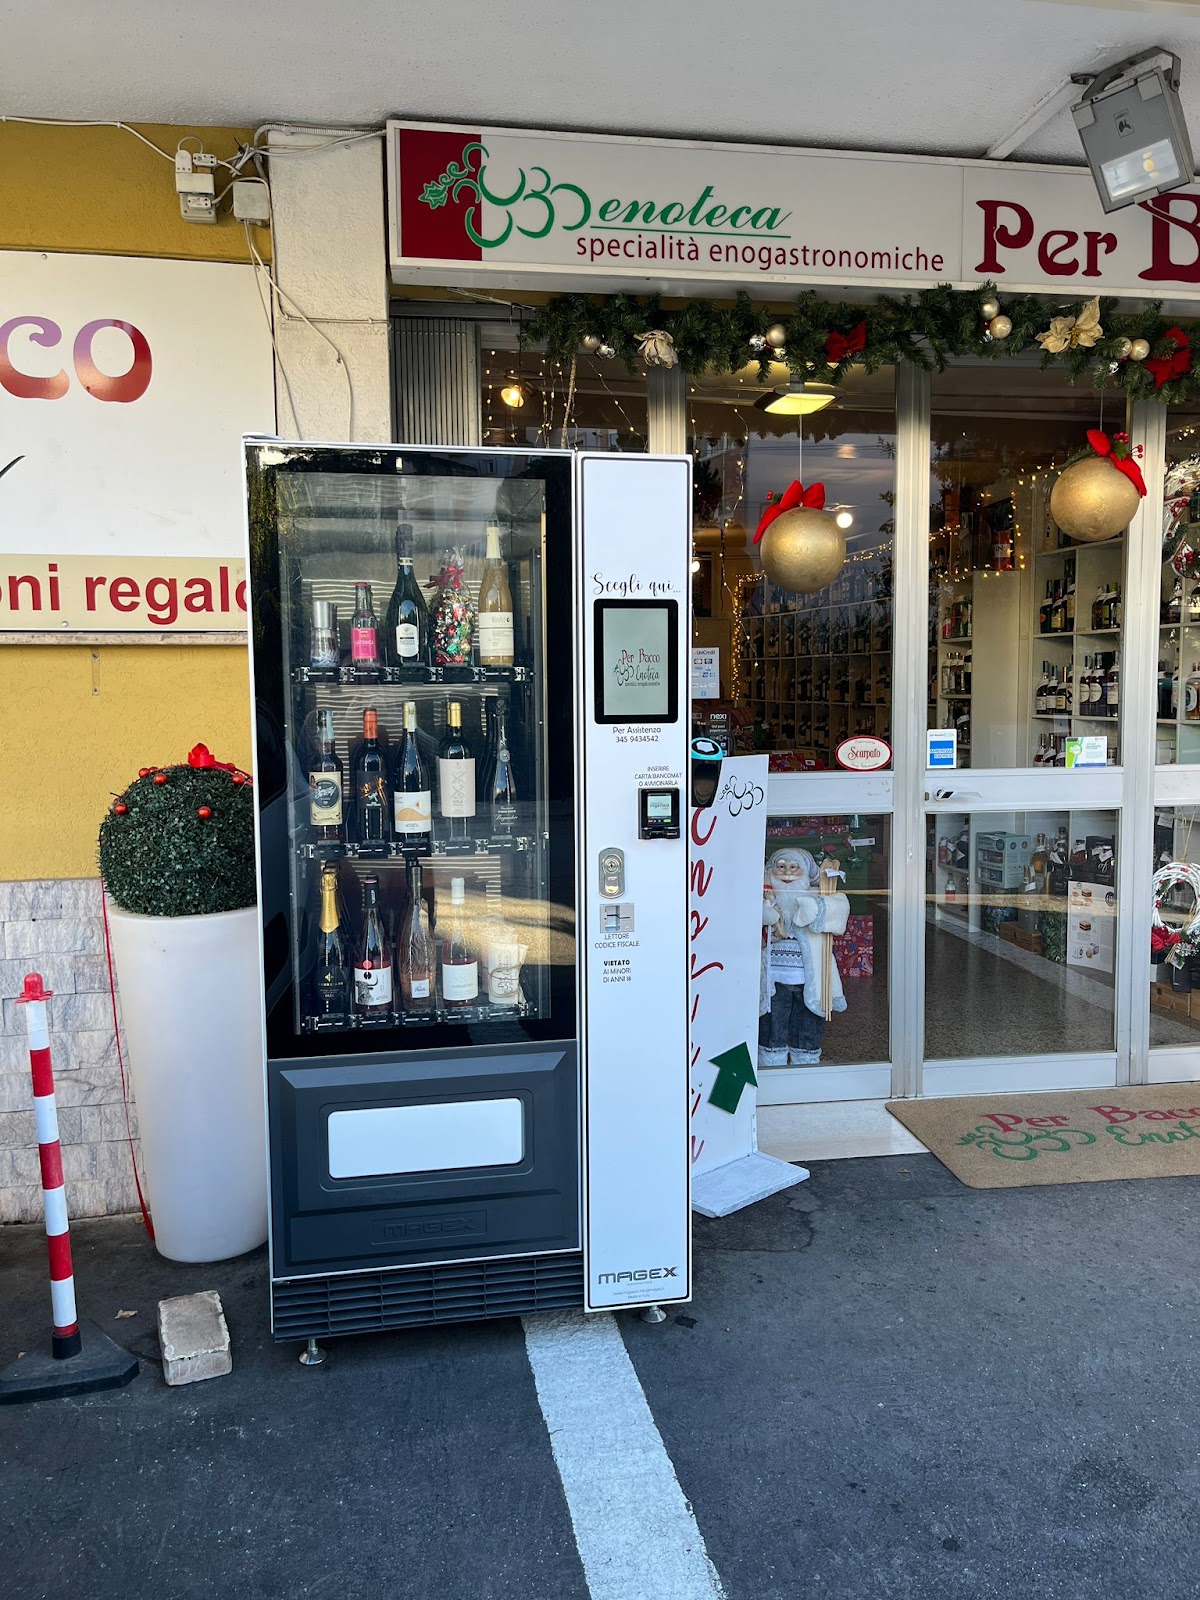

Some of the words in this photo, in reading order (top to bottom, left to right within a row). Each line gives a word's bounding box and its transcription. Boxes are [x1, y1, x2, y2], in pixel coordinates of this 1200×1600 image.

[598, 185, 793, 230] enoteca
[975, 199, 1118, 277] Per
[576, 234, 699, 262] specialità
[709, 242, 945, 272] enogastronomiche
[0, 563, 61, 611] ni
[590, 571, 644, 598] Scegli
[621, 649, 635, 665] Per
[638, 648, 660, 664] Bacco
[635, 664, 660, 681] Enoteca
[612, 726, 626, 735] Per
[626, 726, 662, 735] Assistenza
[615, 735, 628, 743] 345
[629, 735, 660, 743] 9434542
[847, 746, 881, 761] Scarpato
[652, 772, 682, 780] BANCOMAT
[594, 941, 617, 949] CODICE
[617, 940, 640, 948] FISCALE
[604, 932, 630, 941] LETTORE
[603, 959, 631, 967] VIETATO
[610, 967, 632, 975] MINORI
[610, 975, 626, 983] ANNI
[981, 1113, 1070, 1133] Per
[598, 1266, 679, 1285] MAGEX
